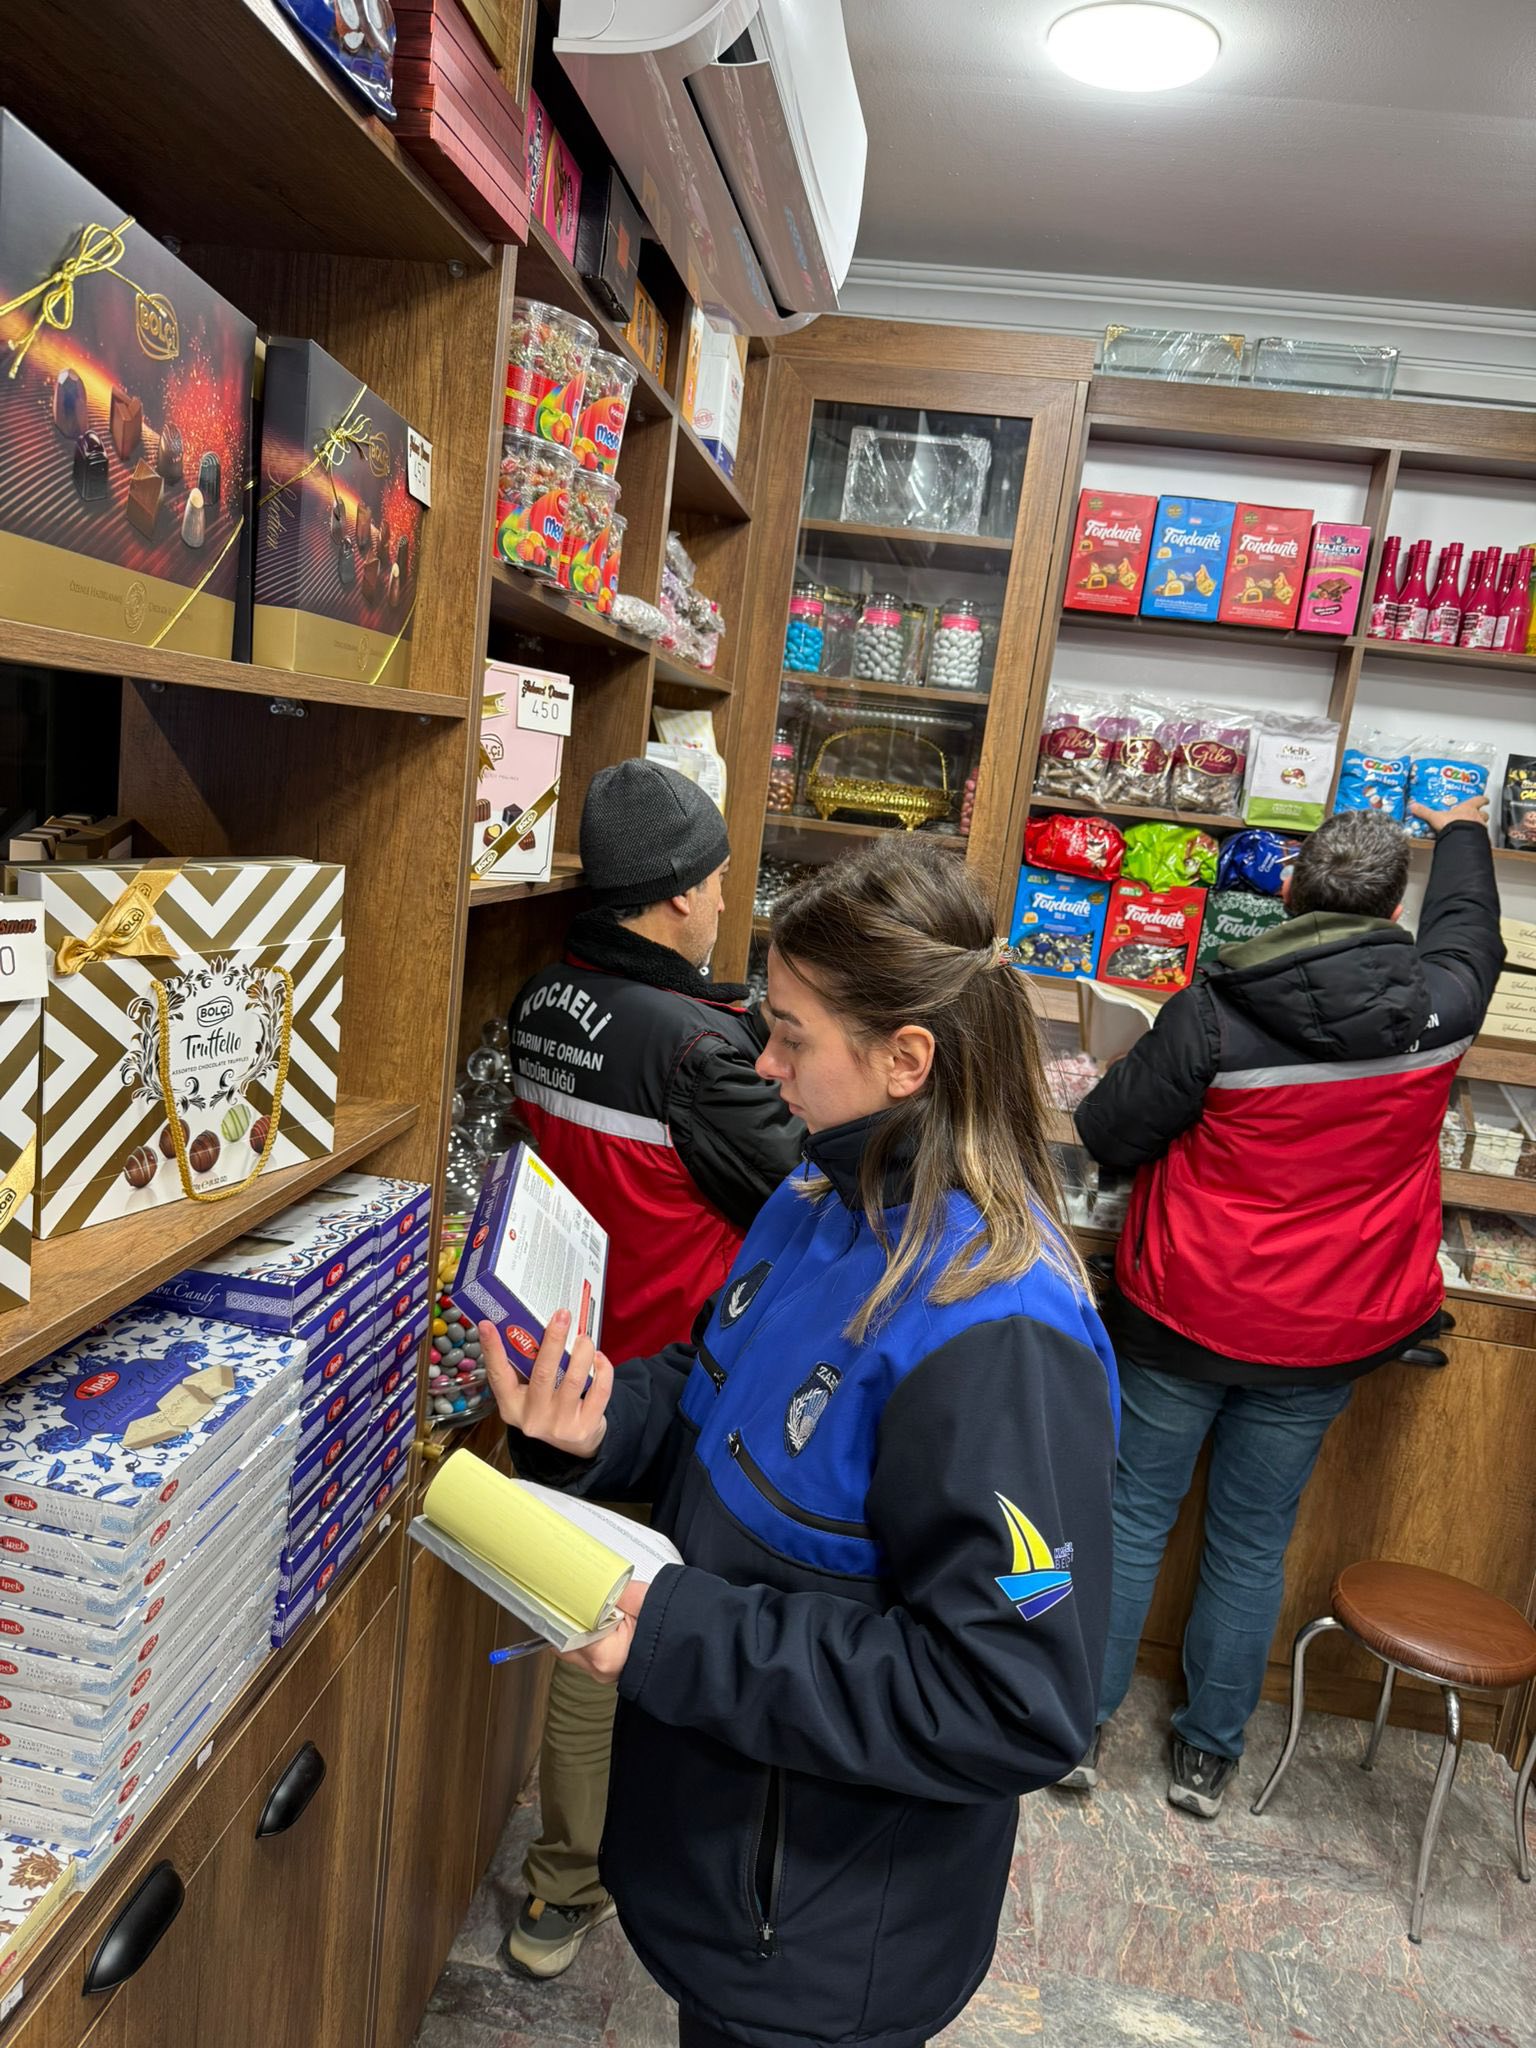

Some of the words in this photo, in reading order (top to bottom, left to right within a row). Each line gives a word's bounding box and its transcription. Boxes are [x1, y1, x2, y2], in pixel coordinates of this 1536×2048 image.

[1085, 519, 1143, 544] Fondante
[1163, 527, 1221, 551] Fondante
[1239, 534, 1299, 559] Fondante
[1315, 543, 1360, 554] MAJESTY
[532, 699, 559, 720] 450
[1191, 744, 1234, 765] Giba
[1032, 892, 1091, 917] Fondante
[1124, 903, 1185, 930] Fondante
[0, 919, 37, 935] sman
[200, 1005, 231, 1019] BOLÇi
[519, 981, 613, 1042] KOCAELİ
[181, 1027, 242, 1060] Truffello
[516, 1029, 543, 1053] TARIM
[543, 1038, 557, 1058] VE
[556, 1042, 604, 1072] ORMAN
[172, 1066, 198, 1075] ASSORTED
[198, 1060, 226, 1071] CHOCOLATE
[227, 1056, 249, 1065] TRUFFLES
[518, 1057, 576, 1094] MÜDÜRLÜĞÜ
[174, 1282, 222, 1314] Candy
[87, 1373, 116, 1393] ipek
[13, 1496, 34, 1509] ipek
[45, 1508, 68, 1517] PALACE
[73, 1515, 93, 1523] HALVA
[46, 1503, 93, 1518] TRADITIONAL
[36, 1550, 60, 1560] PALACE
[64, 1557, 84, 1565] HALVA
[37, 1545, 84, 1560] TRADITIONAL
[1, 1579, 22, 1592] ipek
[32, 1591, 55, 1600] PALACE
[1, 1621, 22, 1634] ipek
[32, 1632, 56, 1641] PALACE
[18, 1739, 65, 1754] TRADITIONAL
[18, 1744, 41, 1753] PALACE
[44, 1750, 64, 1758] HALVA
[9, 1777, 55, 1792] TRADITIONAL
[9, 1783, 32, 1791] PALACE
